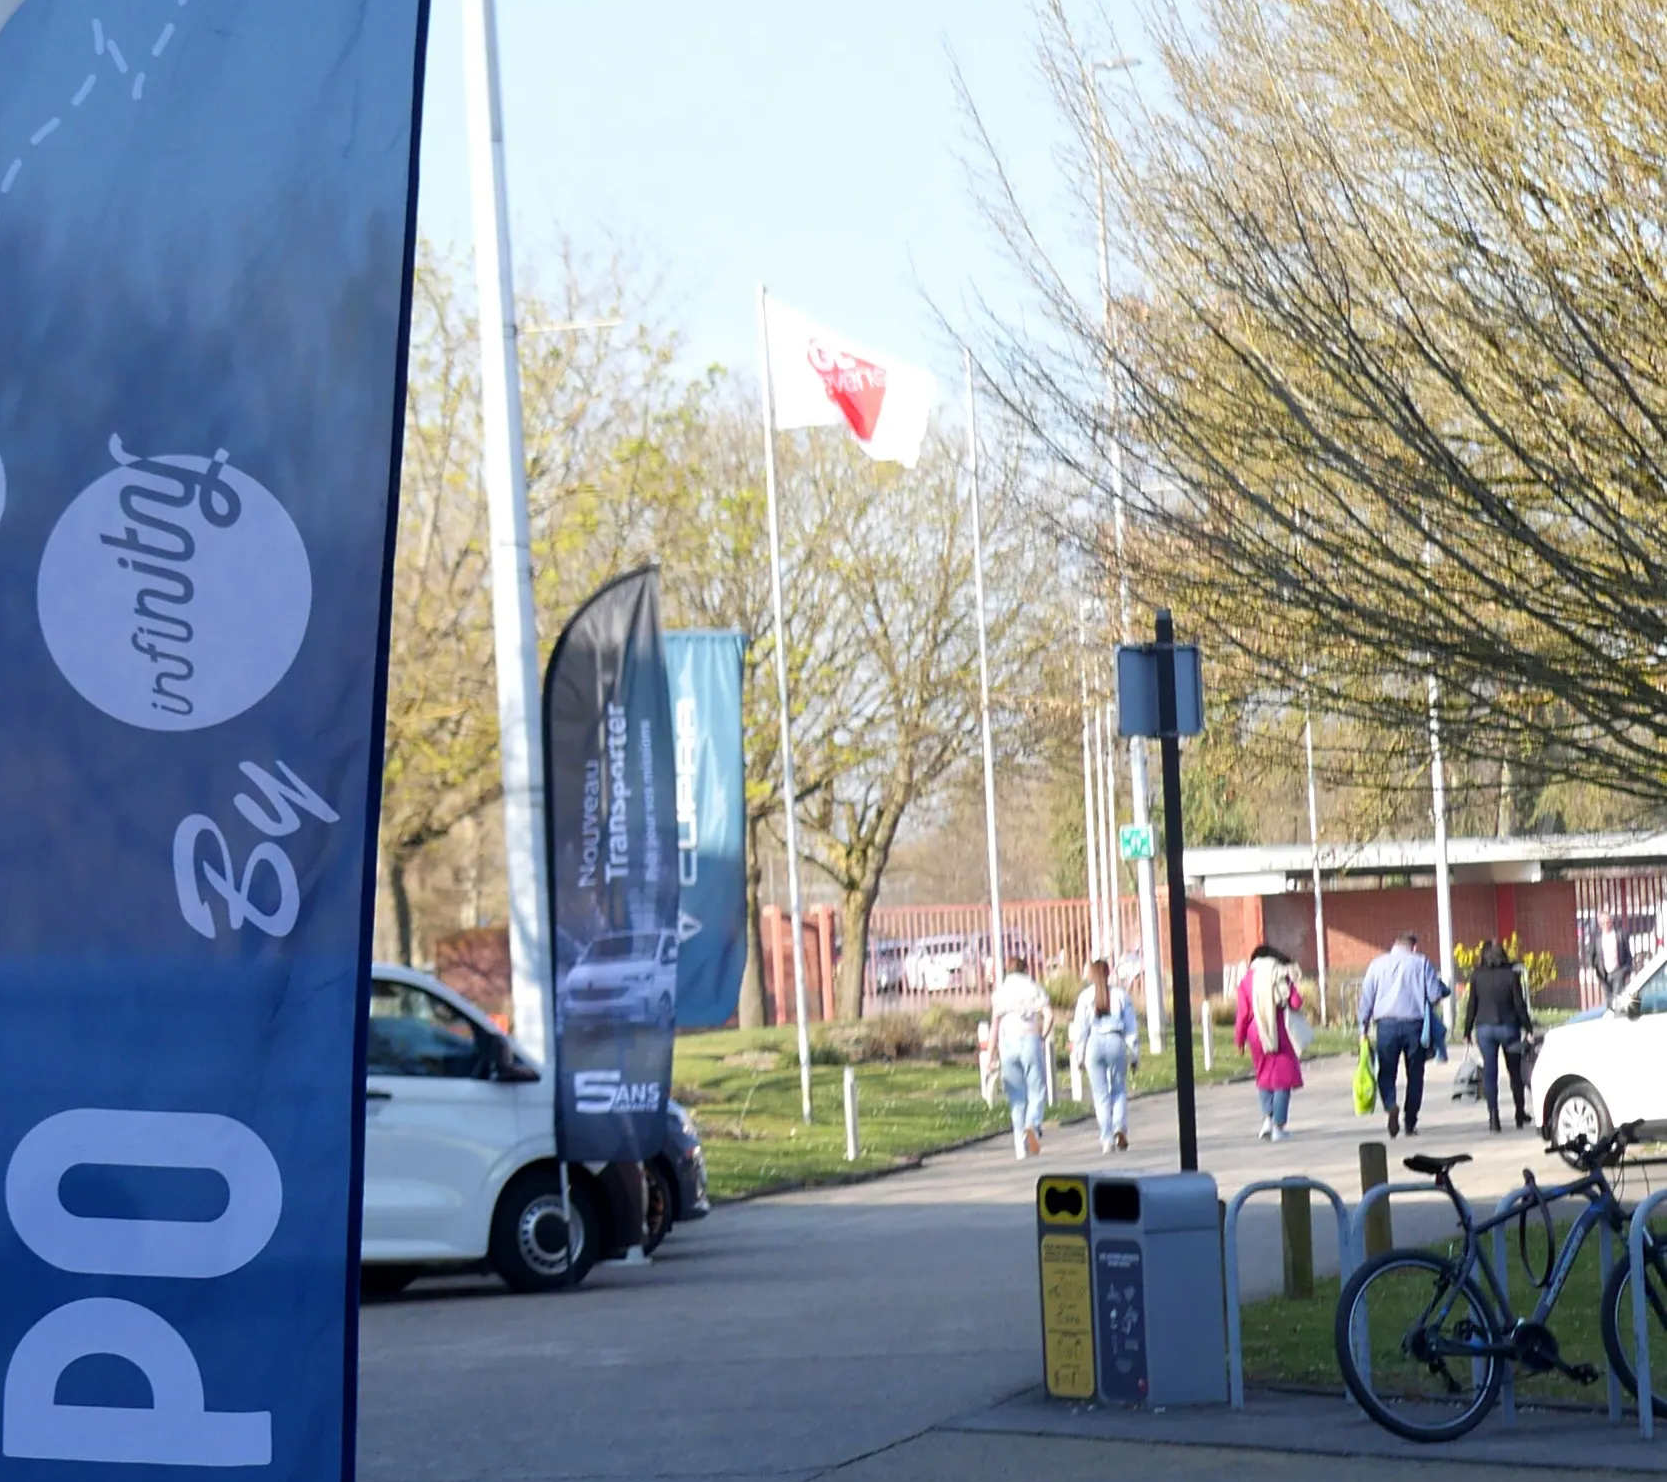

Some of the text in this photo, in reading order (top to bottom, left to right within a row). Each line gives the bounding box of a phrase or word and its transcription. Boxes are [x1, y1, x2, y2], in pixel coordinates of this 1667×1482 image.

[99, 432, 340, 940] By infinity
[577, 759, 600, 888] Nouveau
[605, 702, 631, 884] Transporter
[676, 698, 697, 885] CUPRA
